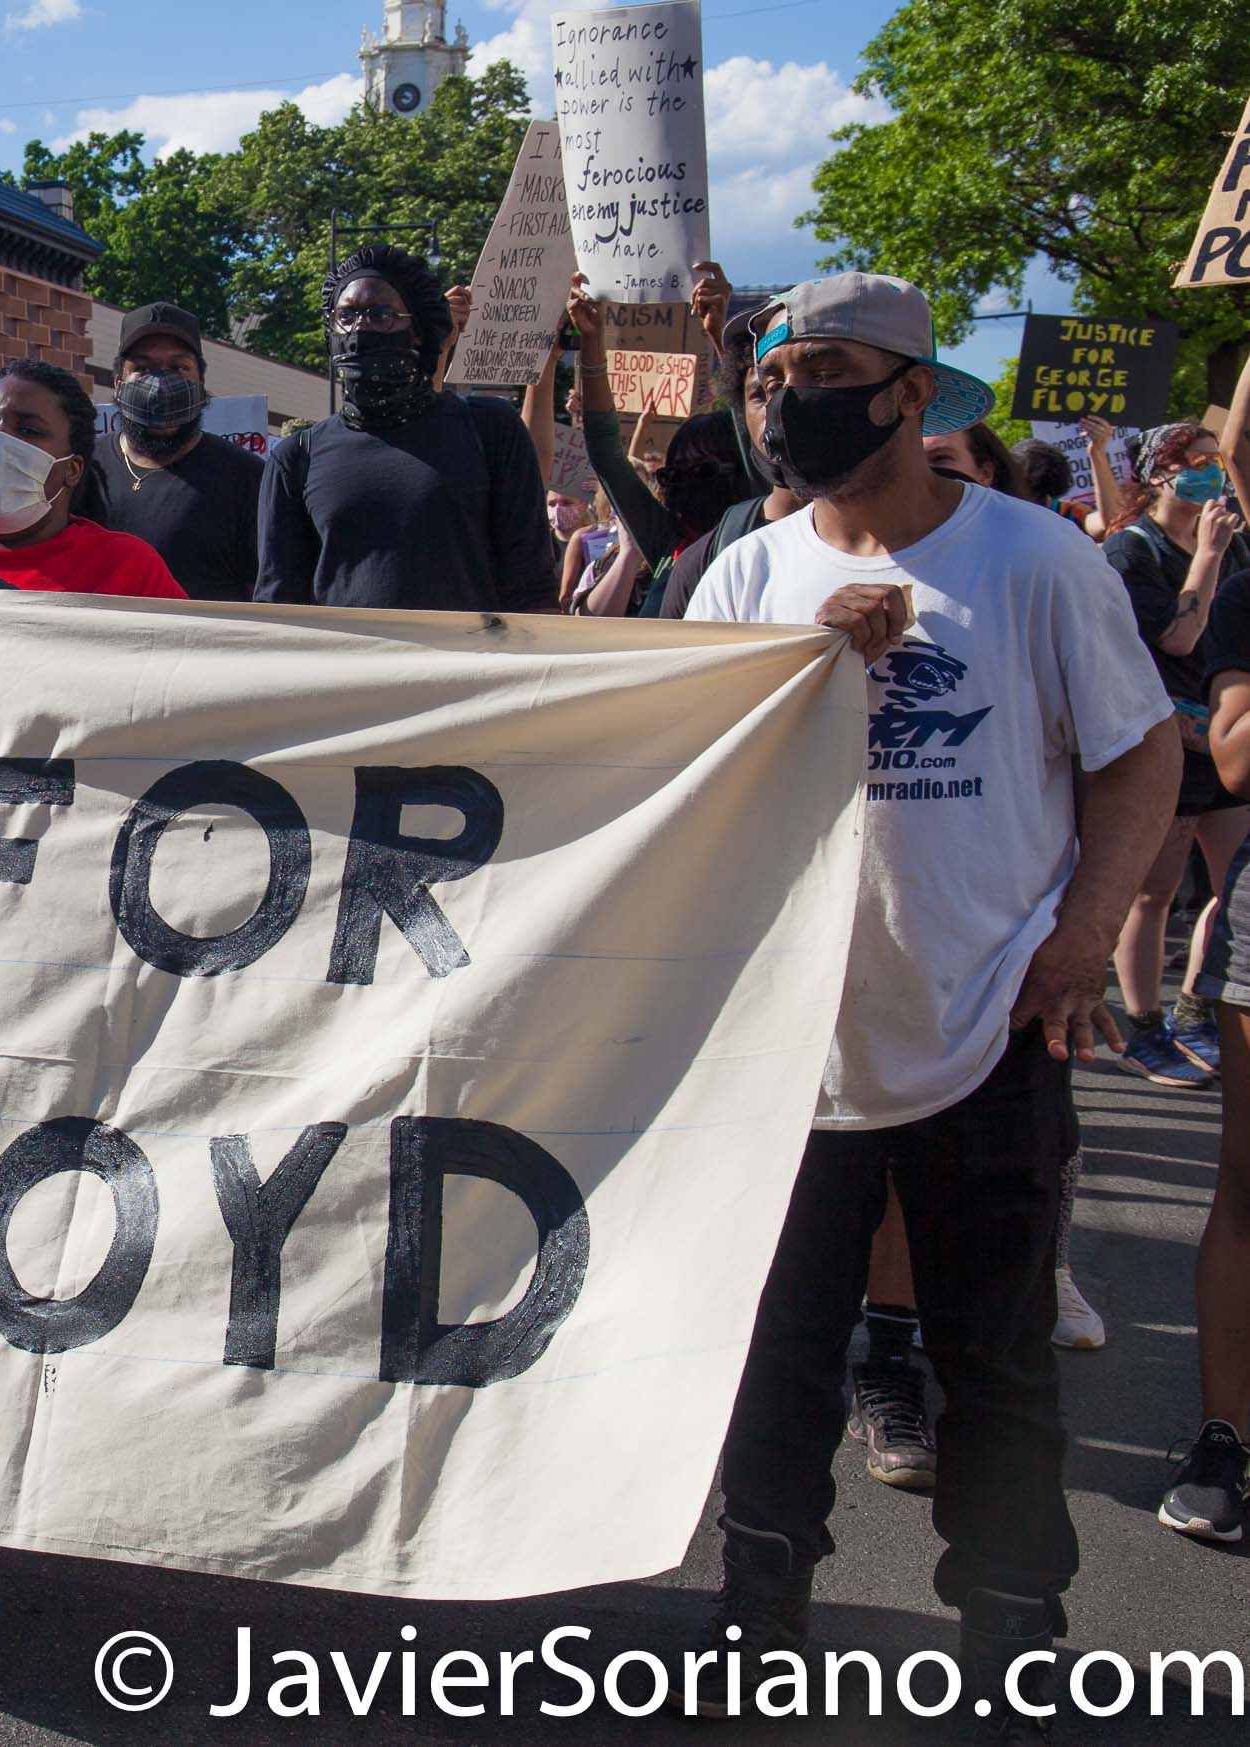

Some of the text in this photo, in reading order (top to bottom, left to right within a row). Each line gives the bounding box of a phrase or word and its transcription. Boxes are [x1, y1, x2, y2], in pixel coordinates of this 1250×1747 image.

[557, 21, 668, 63] Ignorance
[565, 50, 680, 90] allied with
[561, 90, 686, 127] power is the
[529, 132, 549, 158] I
[565, 128, 601, 153] most
[578, 155, 686, 191] ferocious
[509, 212, 545, 236] FIRST
[572, 193, 706, 243] enemy justice
[500, 247, 544, 270] WATER
[612, 237, 663, 258] have.
[1190, 226, 1250, 284] PO
[490, 275, 537, 300] SNACKS
[482, 302, 541, 322] SUNSCREEN
[605, 305, 673, 329] ACISM
[474, 329, 498, 346] LOVE
[1059, 319, 1155, 347] JUSTICE
[464, 348, 507, 367] STANDING
[614, 352, 654, 372] BLOOD
[665, 356, 695, 377] SHED
[1072, 347, 1115, 364] FOR
[607, 373, 637, 393] THIS
[1036, 366, 1129, 387] GEORGE
[639, 375, 689, 416] WAR
[1032, 388, 1127, 413] FLOYD
[868, 749, 957, 770] DIO.com
[867, 777, 982, 801] mradio.net
